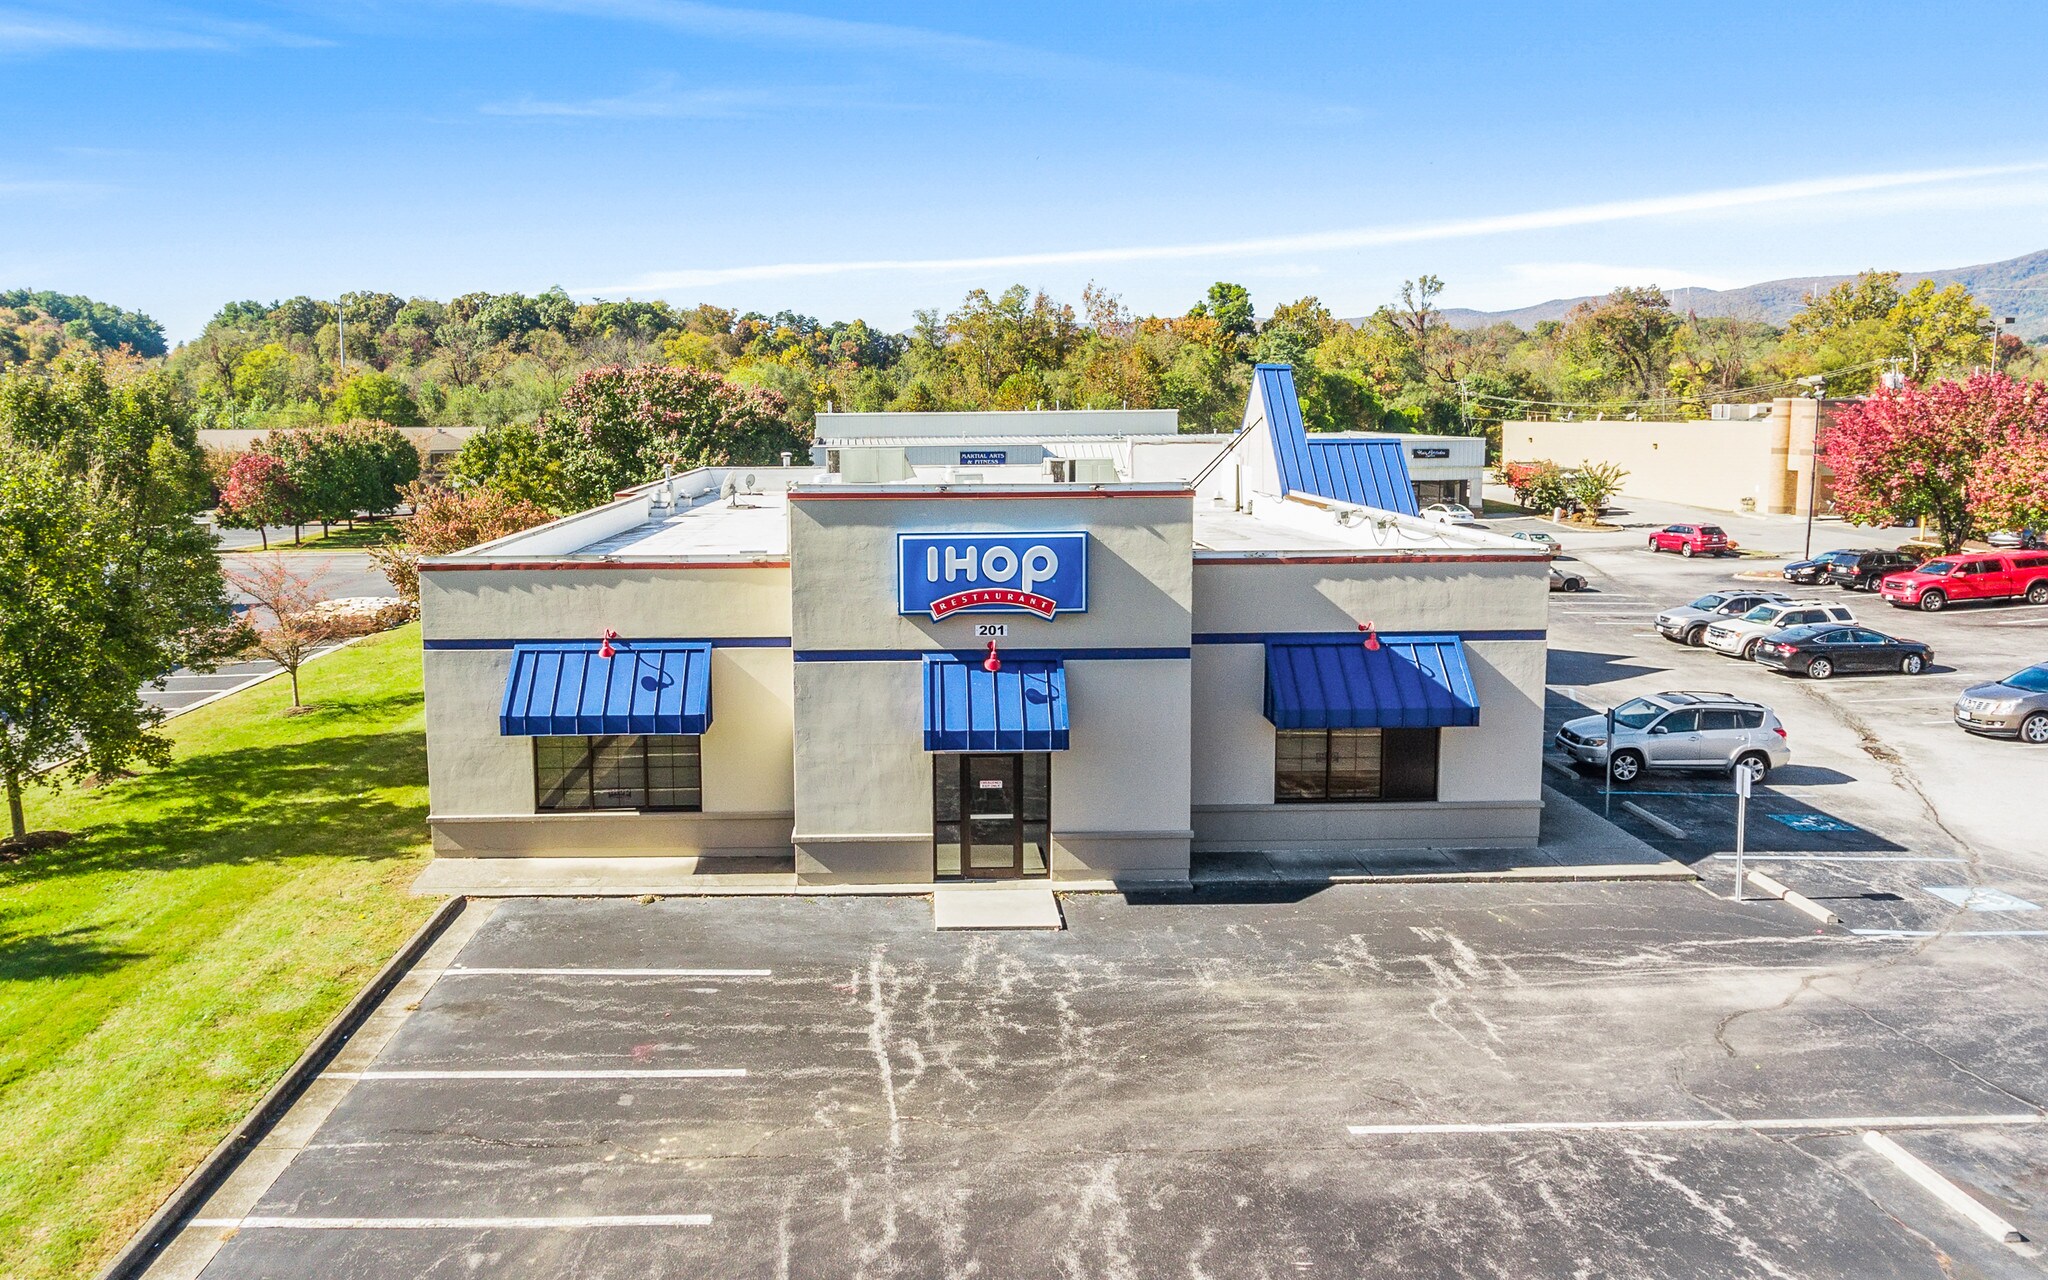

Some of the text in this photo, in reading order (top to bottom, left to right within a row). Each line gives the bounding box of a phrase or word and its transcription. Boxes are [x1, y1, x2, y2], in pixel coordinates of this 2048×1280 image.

[927, 545, 1059, 594] IHOP
[939, 592, 1048, 611] RESTAURANT
[979, 625, 1005, 636] 201
